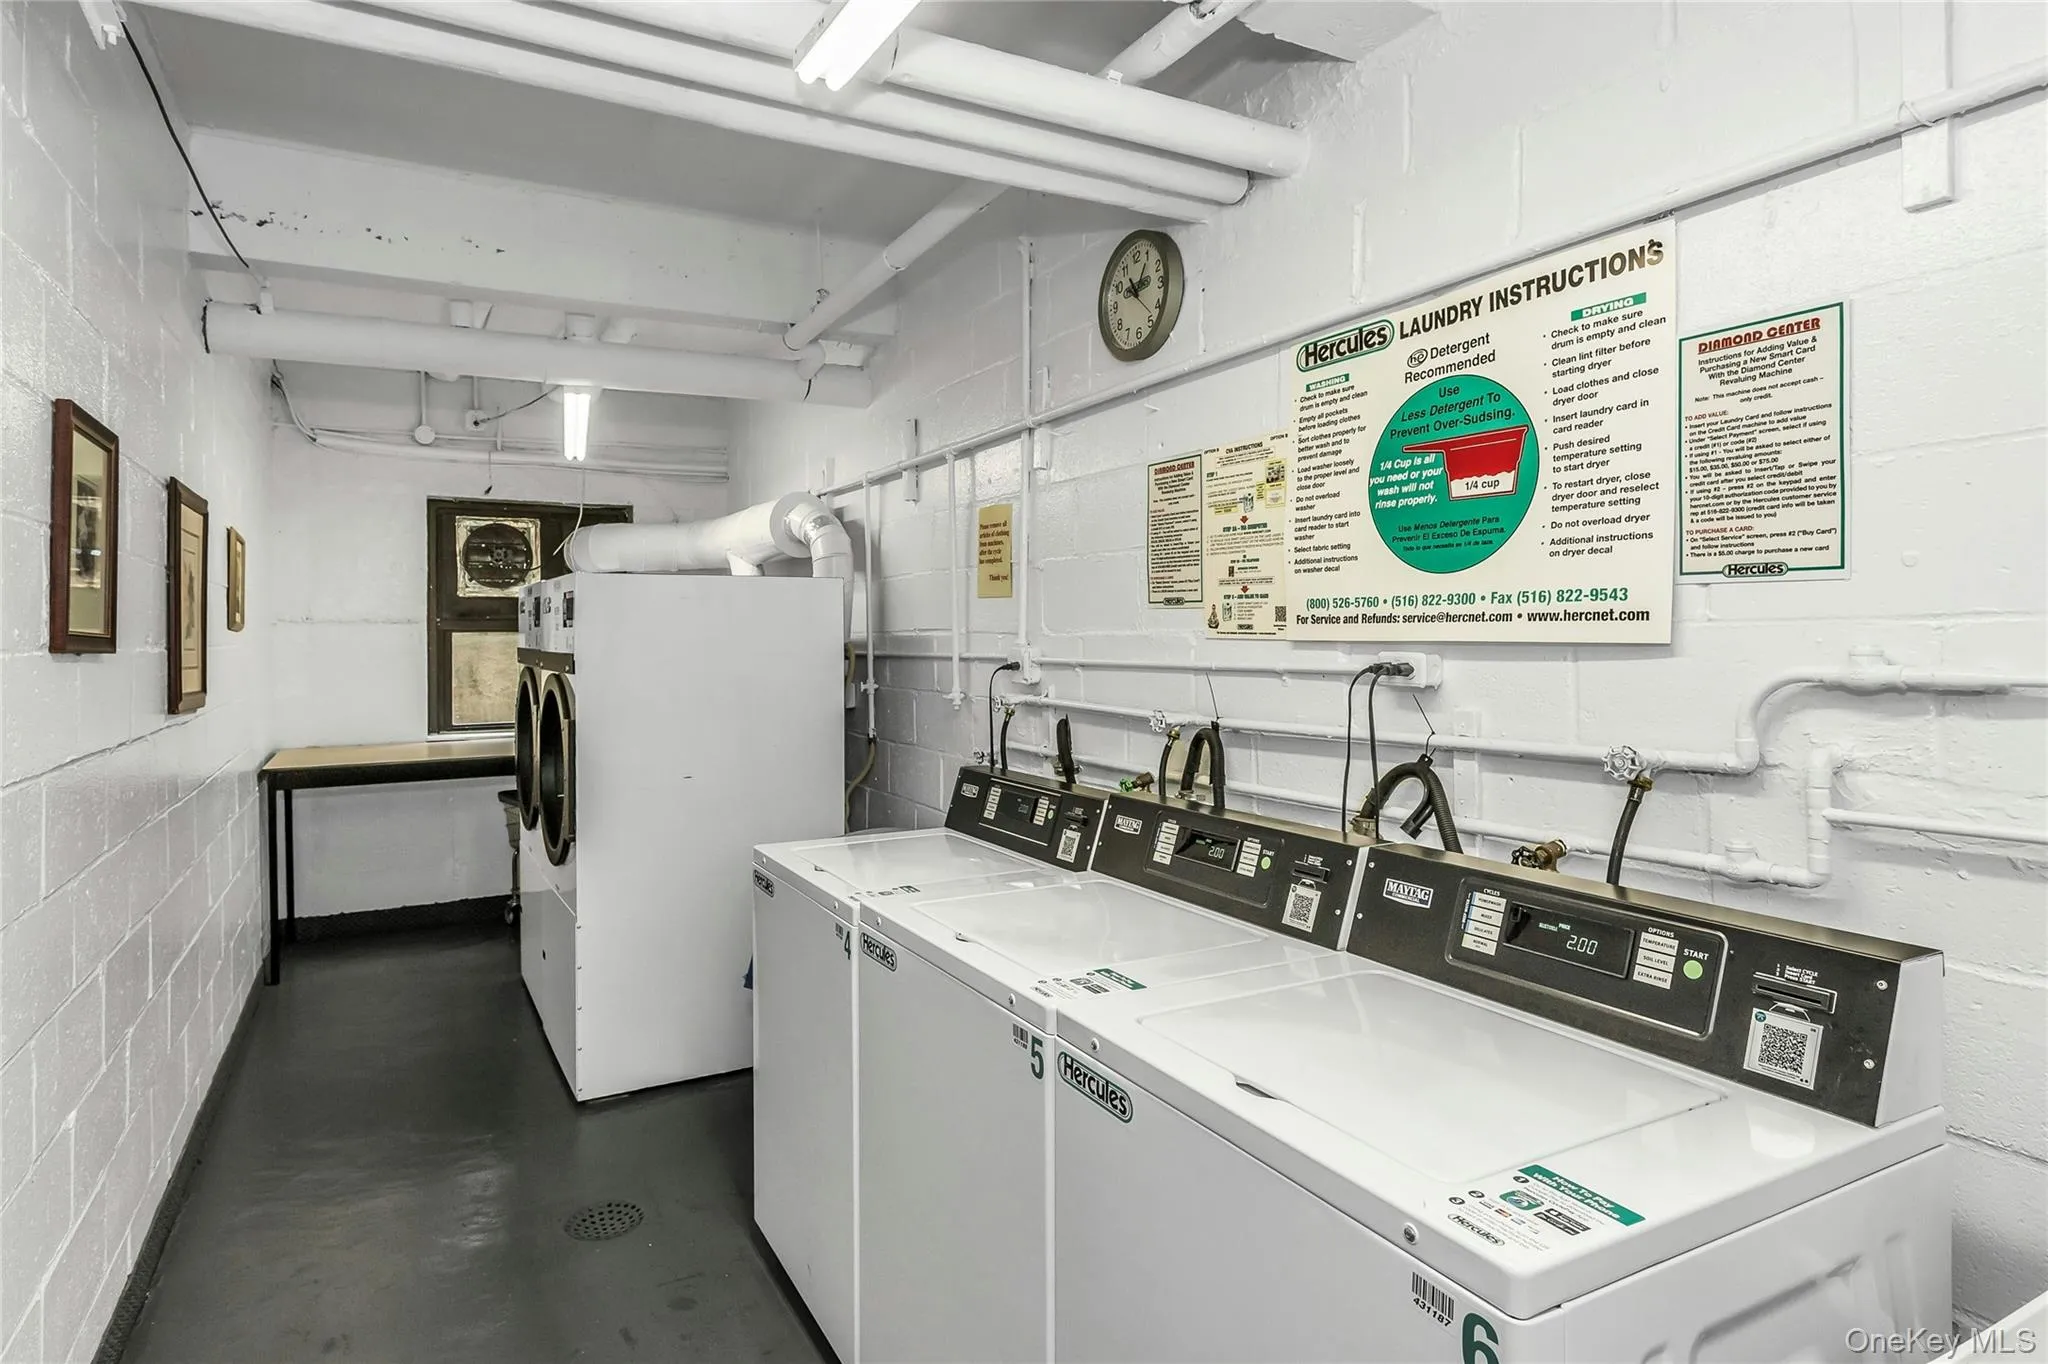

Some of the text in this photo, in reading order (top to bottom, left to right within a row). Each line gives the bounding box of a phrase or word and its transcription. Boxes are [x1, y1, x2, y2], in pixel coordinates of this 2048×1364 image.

[1132, 250, 1141, 264] 12
[1145, 250, 1149, 261] 1
[1155, 259, 1161, 272] 2
[1158, 276, 1164, 289] 3
[1399, 238, 1663, 340] LAUNDRY INSTRUCTIONS
[1112, 301, 1118, 314] 9
[1154, 298, 1160, 309] 4
[1582, 296, 1635, 320] DRYING
[1117, 318, 1122, 330] 8
[1148, 314, 1154, 328] 5
[1550, 310, 1643, 339] Check to make sure
[1125, 328, 1130, 340] 7
[1136, 327, 1142, 340] 6
[1551, 316, 1666, 350] drum is empty and clean
[1698, 317, 1821, 354] DIAMOND CENTER
[1304, 324, 1388, 366] Hercules
[1430, 332, 1490, 359] Detergent
[1551, 338, 1651, 367] Clean lint filter before
[1698, 352, 1742, 366] Instructions
[1756, 343, 1785, 354] Adding
[1786, 338, 1809, 348] Value
[1810, 335, 1818, 343] &
[1404, 349, 1496, 384] Recommended
[1552, 359, 1612, 378] starting dryer
[1699, 360, 1742, 374] Purchasing
[1749, 355, 1768, 364] New
[1769, 349, 1794, 360] Smart
[1795, 344, 1816, 355] Card
[1708, 371, 1725, 380] With
[1740, 361, 1776, 374] Diamond
[1777, 356, 1806, 367] Center
[1309, 375, 1346, 391] WASHING
[1719, 367, 1793, 386] Revaluing Machine
[1438, 386, 1460, 398] Use
[1400, 392, 1501, 422] Less Detergent To
[1390, 408, 1515, 440] Prevent Over-Sudsing.
[1380, 460, 1393, 471] 1/4
[1393, 458, 1412, 469] Cup
[1423, 453, 1436, 465] all
[1369, 466, 1444, 488] you need or your
[1465, 479, 1500, 491] 1/4 cup
[1377, 480, 1434, 497] wash will not
[1374, 493, 1438, 509] rinse properly.
[1398, 516, 1500, 533] Use Menos Detergente Para
[1728, 562, 1784, 576] Hercules
[1306, 587, 1628, 612] (800) 526-5760 (516) 822-9300 Fax (516) 822-9543
[1296, 608, 1650, 625] For Service and Refunds: service@hercnet.com www.hercnet.com
[1118, 817, 1140, 830] MAYTAG
[754, 870, 774, 896] Hercules
[1387, 881, 1430, 900] MAYTAG
[1484, 888, 1500, 896] CYCLES
[1648, 926, 1674, 938] OPTIONS
[862, 934, 896, 967] Hercules
[1566, 934, 1598, 955] 2.00
[1642, 937, 1676, 949] TEMPERATURE
[1654, 958, 1668, 966] LEVEL
[1683, 948, 1710, 960] START
[1638, 971, 1668, 984] EXTRA RINSE
[1030, 1034, 1044, 1080] 5
[1062, 1054, 1128, 1116] Hercules
[1533, 1172, 1620, 1219] With Your Phone
[1552, 1176, 1615, 1208] How To Pay
[1453, 1215, 1499, 1244] Hercules
[1412, 1296, 1452, 1328] 431187
[1462, 1312, 1500, 1364] 6
